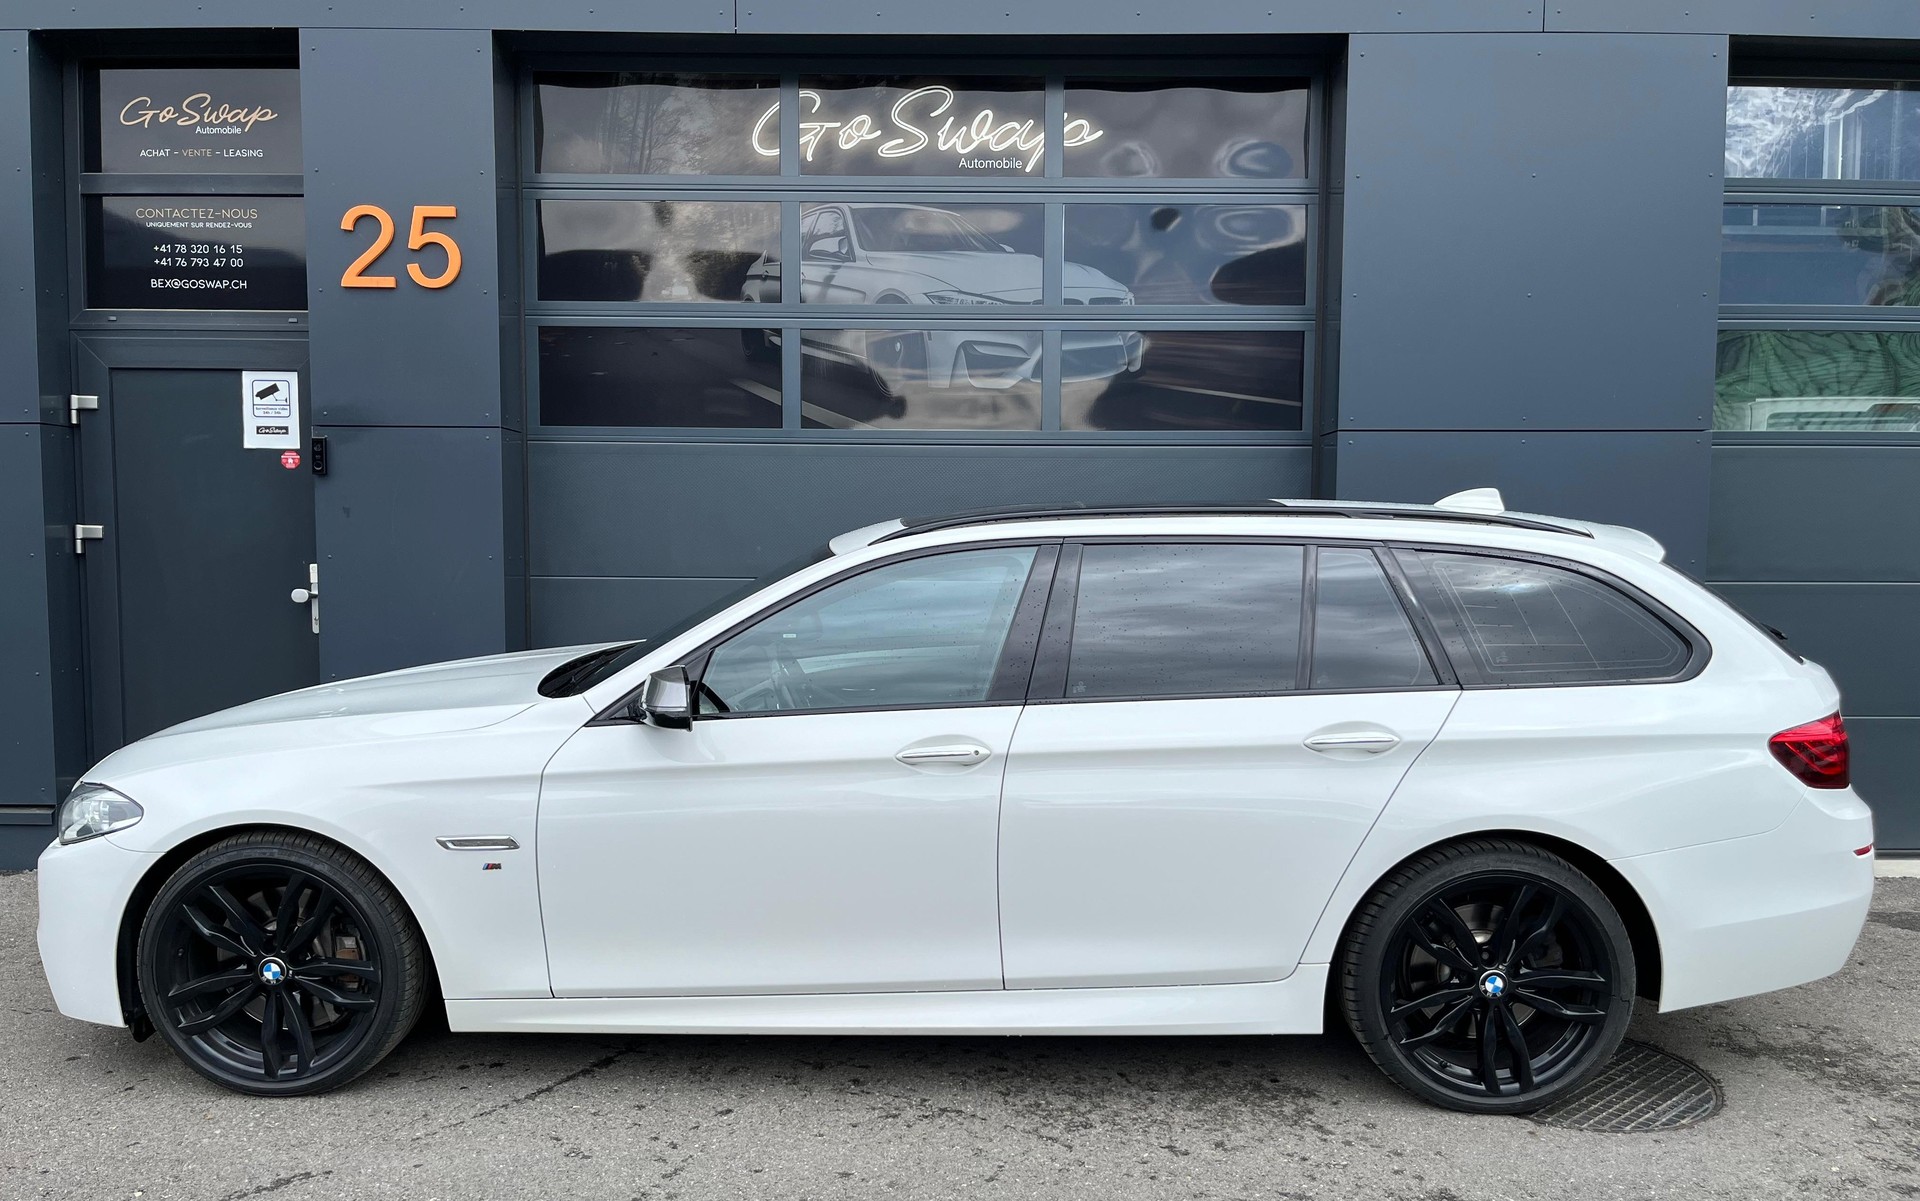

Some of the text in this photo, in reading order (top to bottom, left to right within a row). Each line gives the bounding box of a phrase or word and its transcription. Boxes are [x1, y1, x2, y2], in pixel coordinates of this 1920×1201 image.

[120, 93, 278, 132] GoSwap
[195, 125, 242, 134] Automobile
[139, 149, 171, 157] ACHAT
[182, 149, 212, 157] VENTE
[223, 149, 263, 158] LEASING
[958, 157, 1023, 170] Automobile
[135, 208, 258, 219] CONTACTEZ-NOUS
[153, 244, 243, 254] +41 78 320 16 15
[340, 204, 462, 289] 25
[154, 257, 243, 268] +41 76 793 47 00
[150, 278, 247, 289] BEX@GOSWAP.CH
